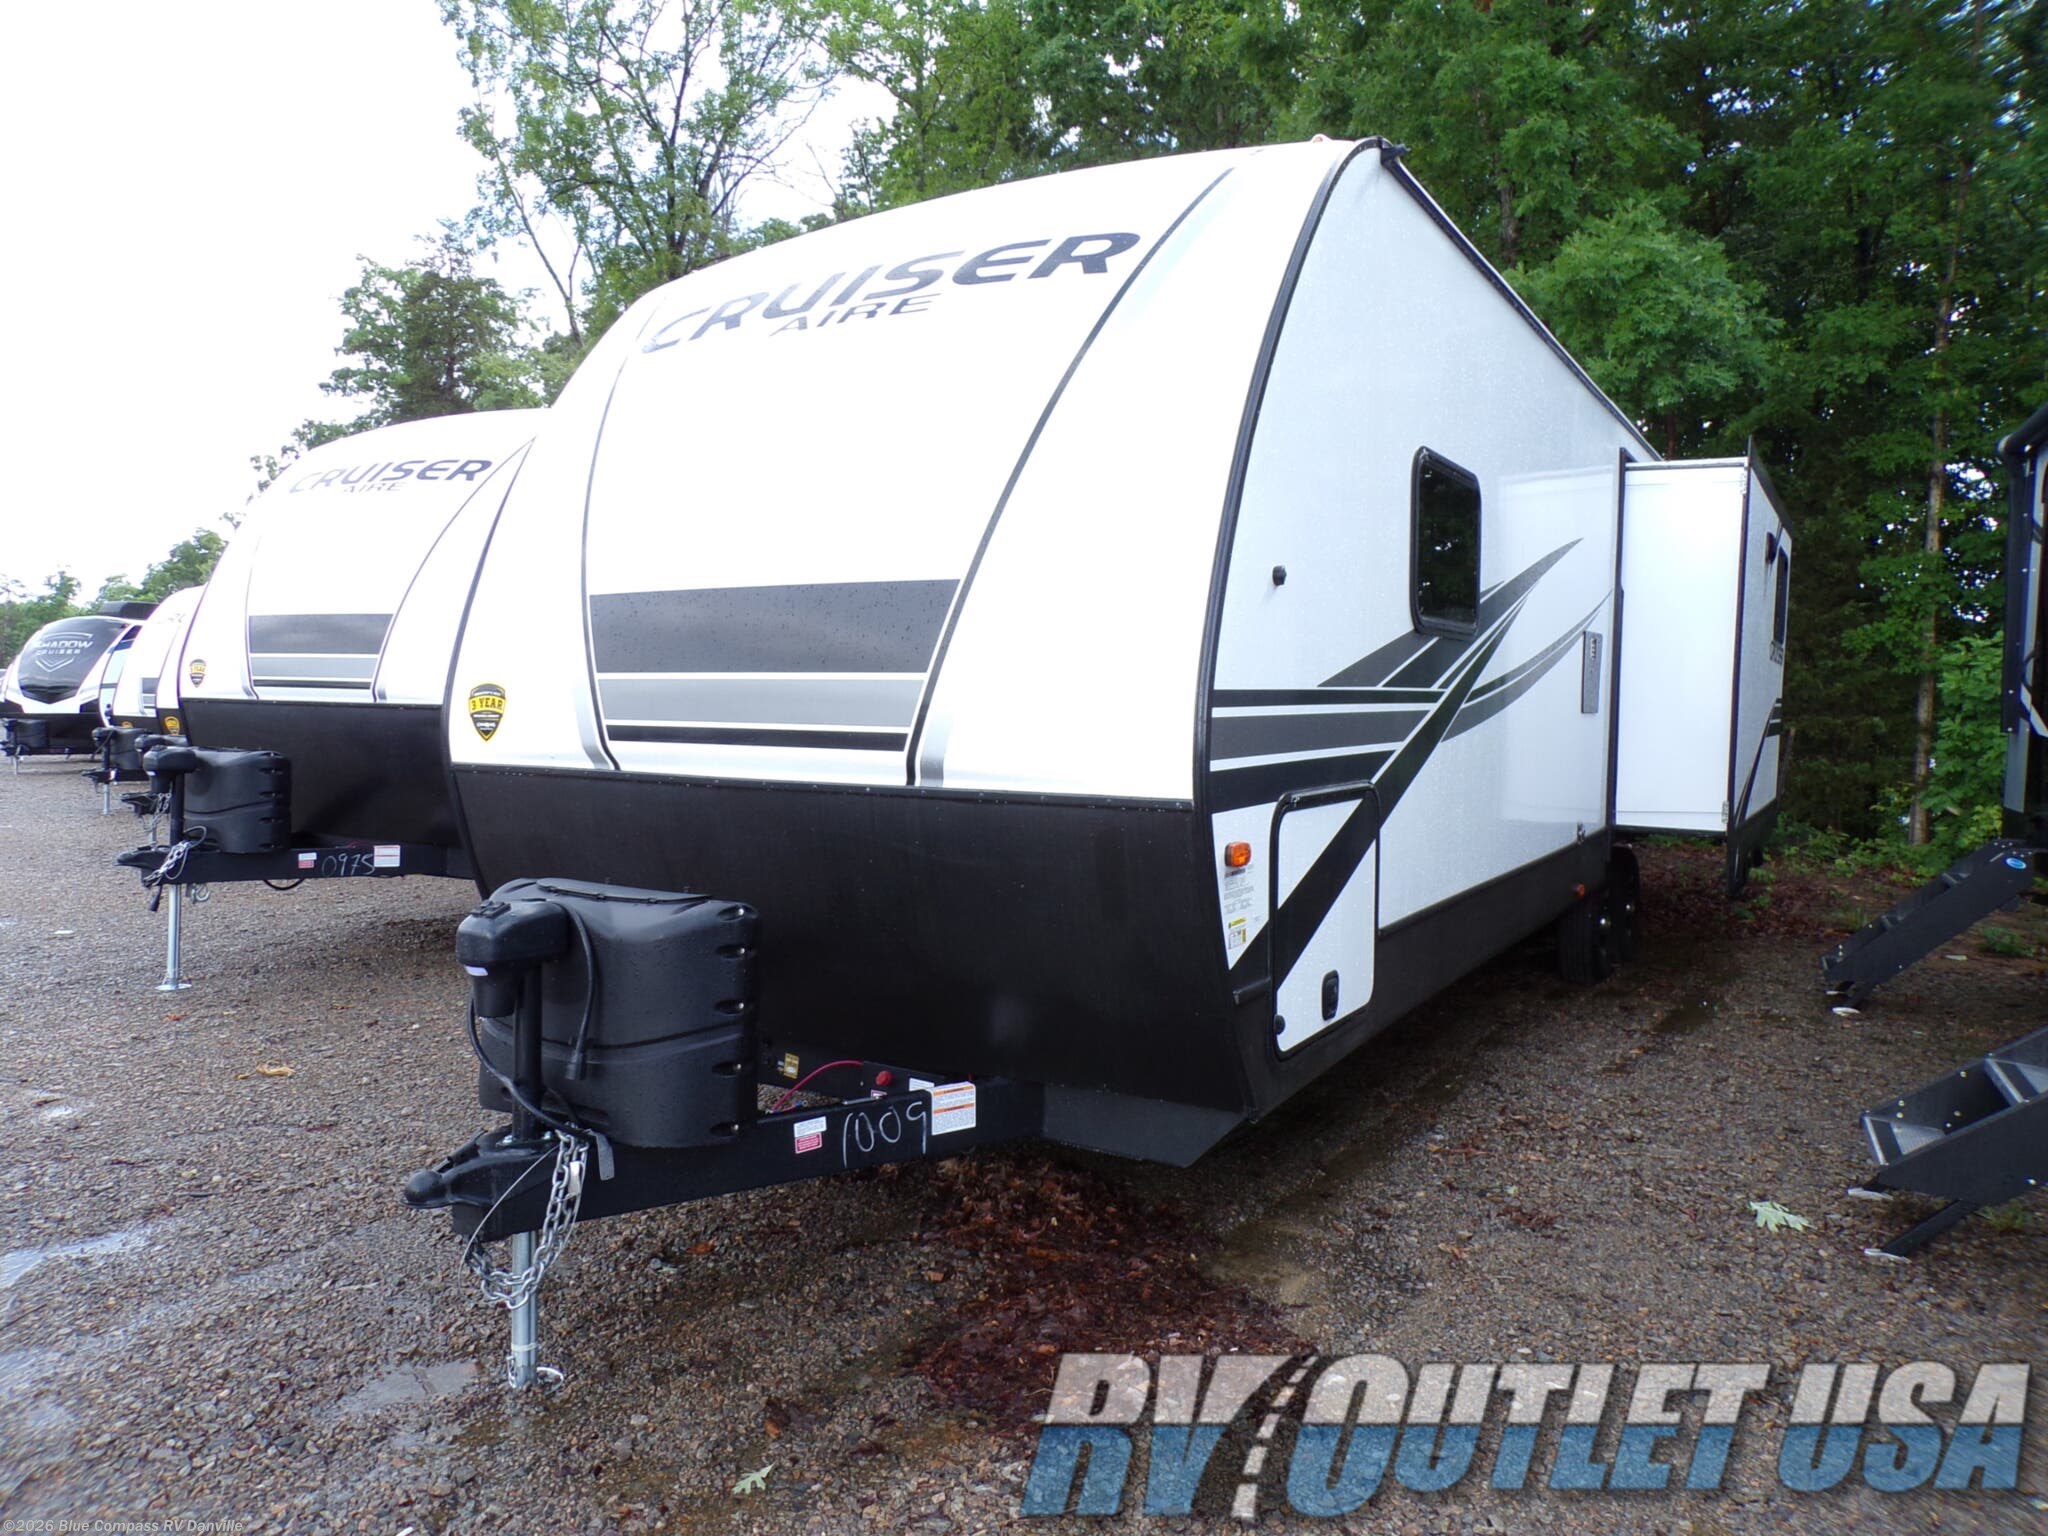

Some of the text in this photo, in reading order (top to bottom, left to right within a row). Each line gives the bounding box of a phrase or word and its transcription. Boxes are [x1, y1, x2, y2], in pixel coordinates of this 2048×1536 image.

[641, 232, 1140, 353] CRUISER
[769, 293, 941, 337] AIRE
[289, 459, 493, 493] CRUISER
[343, 481, 406, 493] AIRE
[479, 697, 503, 710] YEAR
[321, 853, 375, 877] 0975
[842, 1101, 927, 1168] 1009
